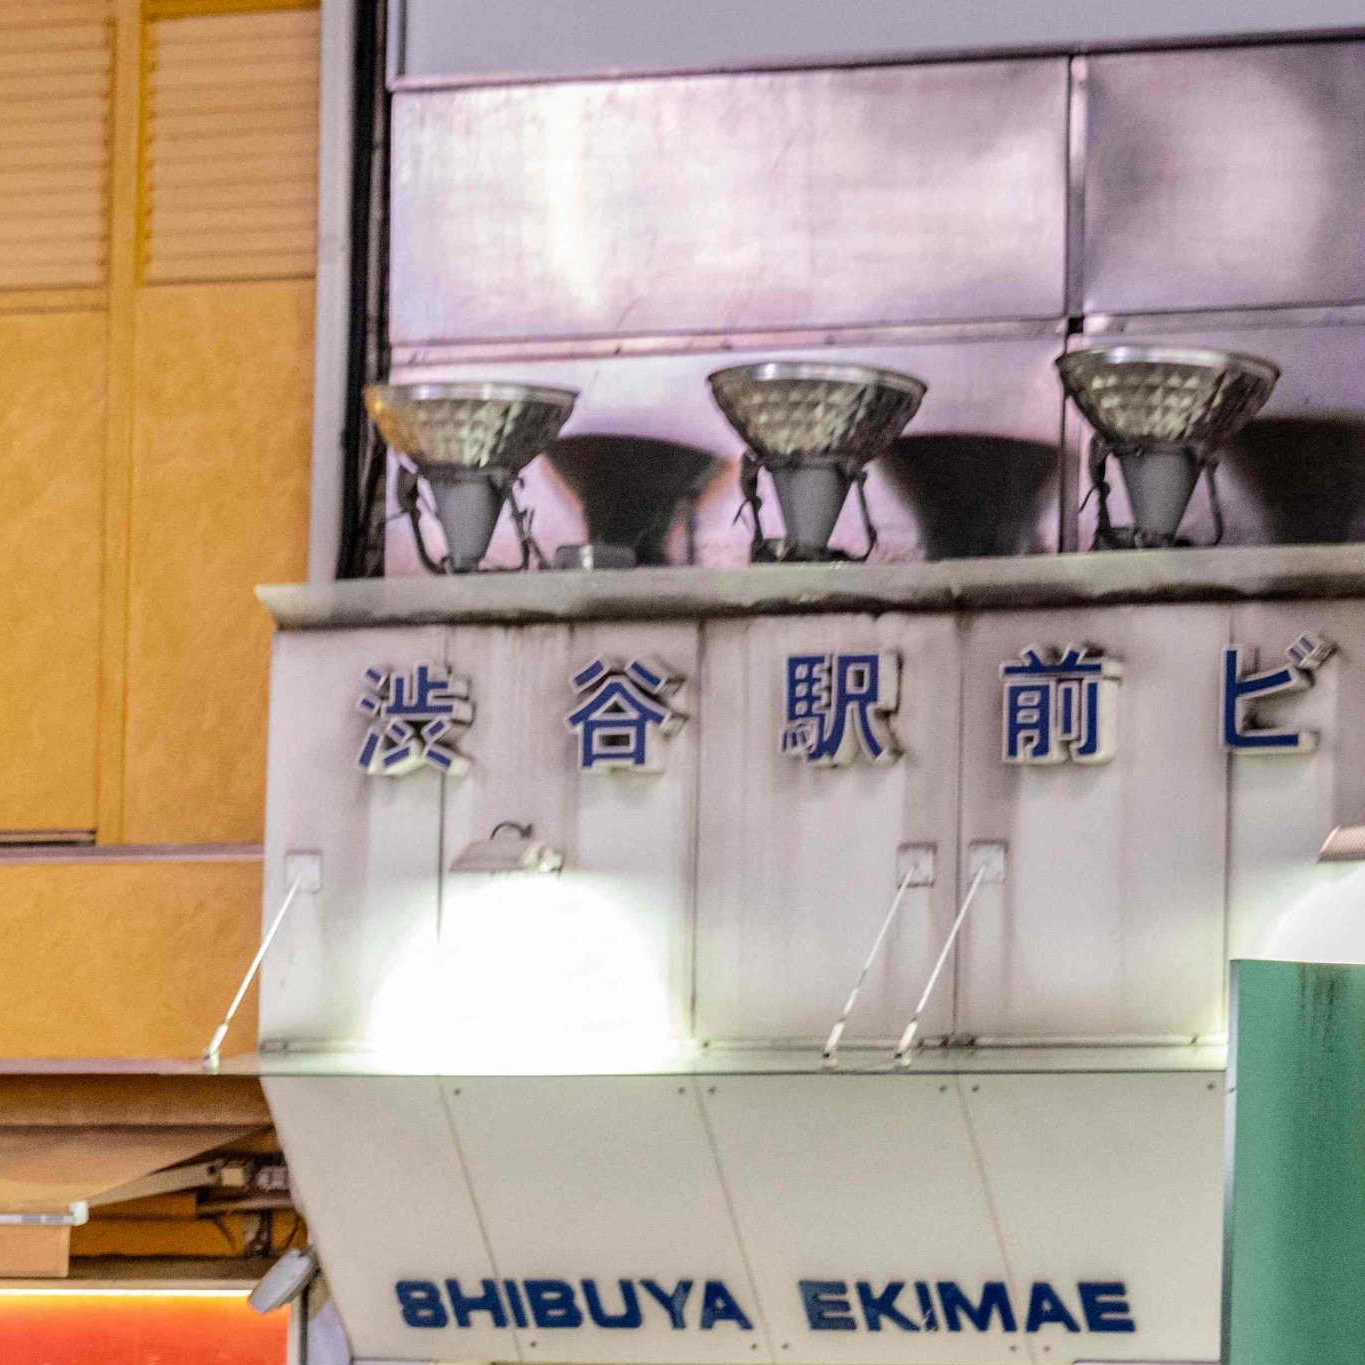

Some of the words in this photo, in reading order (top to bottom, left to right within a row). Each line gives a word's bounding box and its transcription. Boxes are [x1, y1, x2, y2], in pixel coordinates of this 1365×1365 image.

[355, 634, 1332, 774] 渋谷駅前ビ
[395, 1278, 754, 1331] SHIBUYA
[798, 1280, 1137, 1333] EKIMAE
